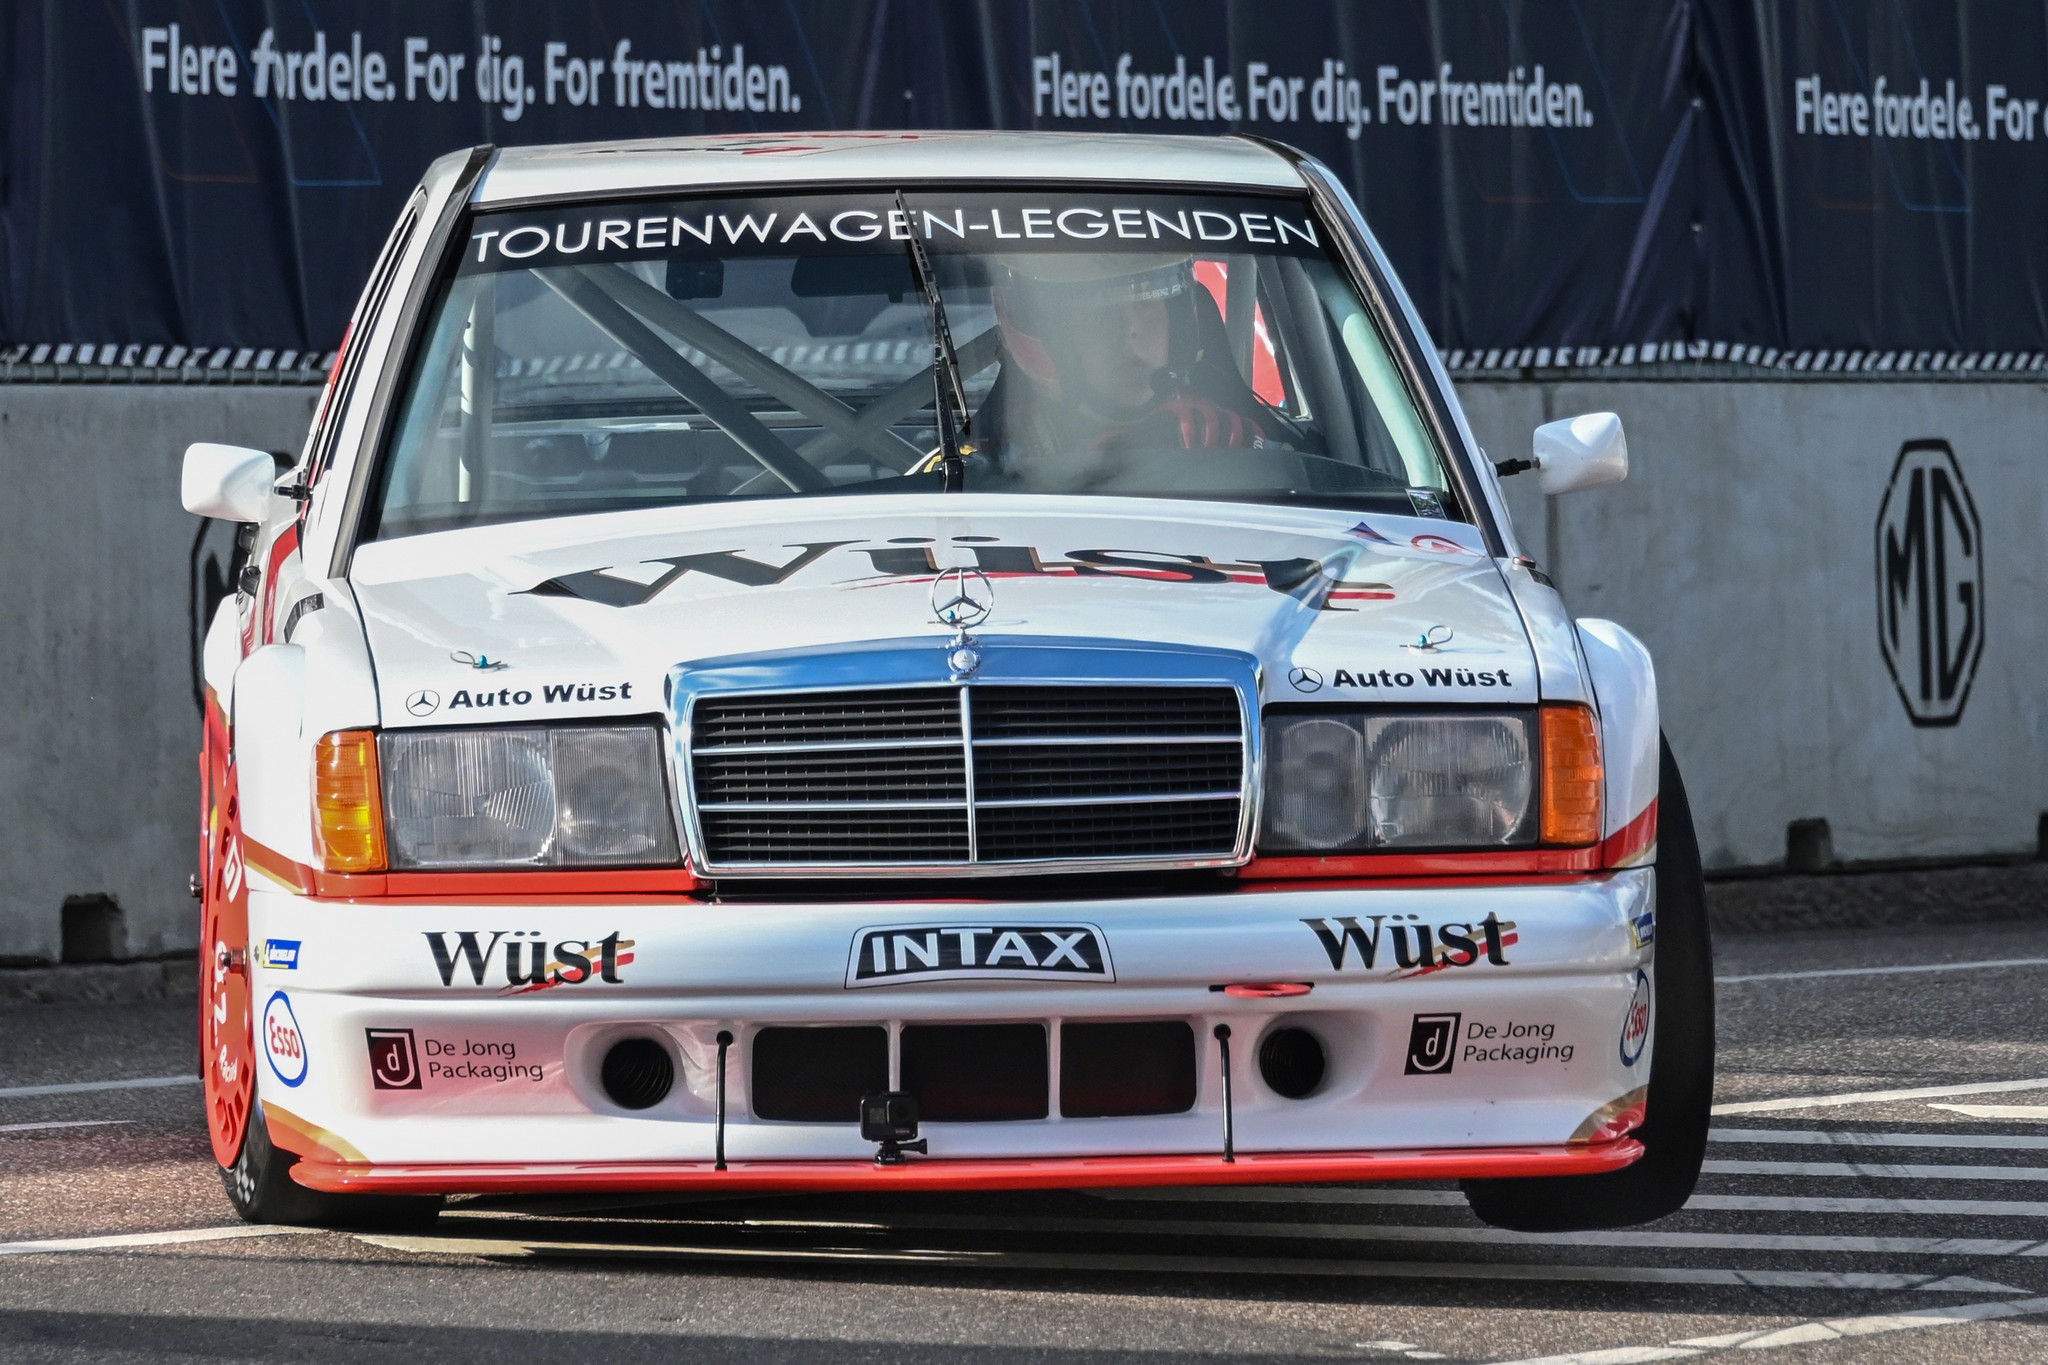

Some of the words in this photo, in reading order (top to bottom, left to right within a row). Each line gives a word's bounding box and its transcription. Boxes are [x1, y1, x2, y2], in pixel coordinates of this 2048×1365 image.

[142, 23, 238, 97] Flere
[250, 27, 397, 102] fordele.
[404, 36, 465, 102] For
[475, 34, 536, 122] dig.
[545, 41, 605, 106] For
[611, 38, 800, 113] fremtiden.
[1032, 52, 1110, 119] Flere
[1117, 53, 1242, 121] fordele.
[1248, 62, 1305, 122] For
[1311, 58, 1371, 140] dig.
[1377, 65, 1436, 124] For
[1438, 62, 1594, 127] fremtiden.
[1795, 73, 1869, 136] Flere
[1872, 75, 1981, 141] fordele.
[1986, 84, 2039, 141] For
[472, 207, 1320, 263] TOURENWAGEN-LEGENDEN
[1886, 467, 1974, 702] MG
[448, 685, 533, 709] Auto
[543, 681, 633, 704] Wüst
[1333, 669, 1414, 688] Auto
[1425, 667, 1512, 688] Wüst
[423, 930, 627, 987] Wüst
[871, 928, 1090, 973] INTAX
[1300, 911, 1511, 971] Wüst
[268, 1015, 301, 1060] Esso
[425, 1039, 456, 1056] De
[462, 1039, 516, 1060] Jong
[1463, 1042, 1574, 1064] Packaging
[1467, 1022, 1497, 1040] De
[1502, 1021, 1555, 1042] Jong
[428, 1061, 544, 1082] Packaging
